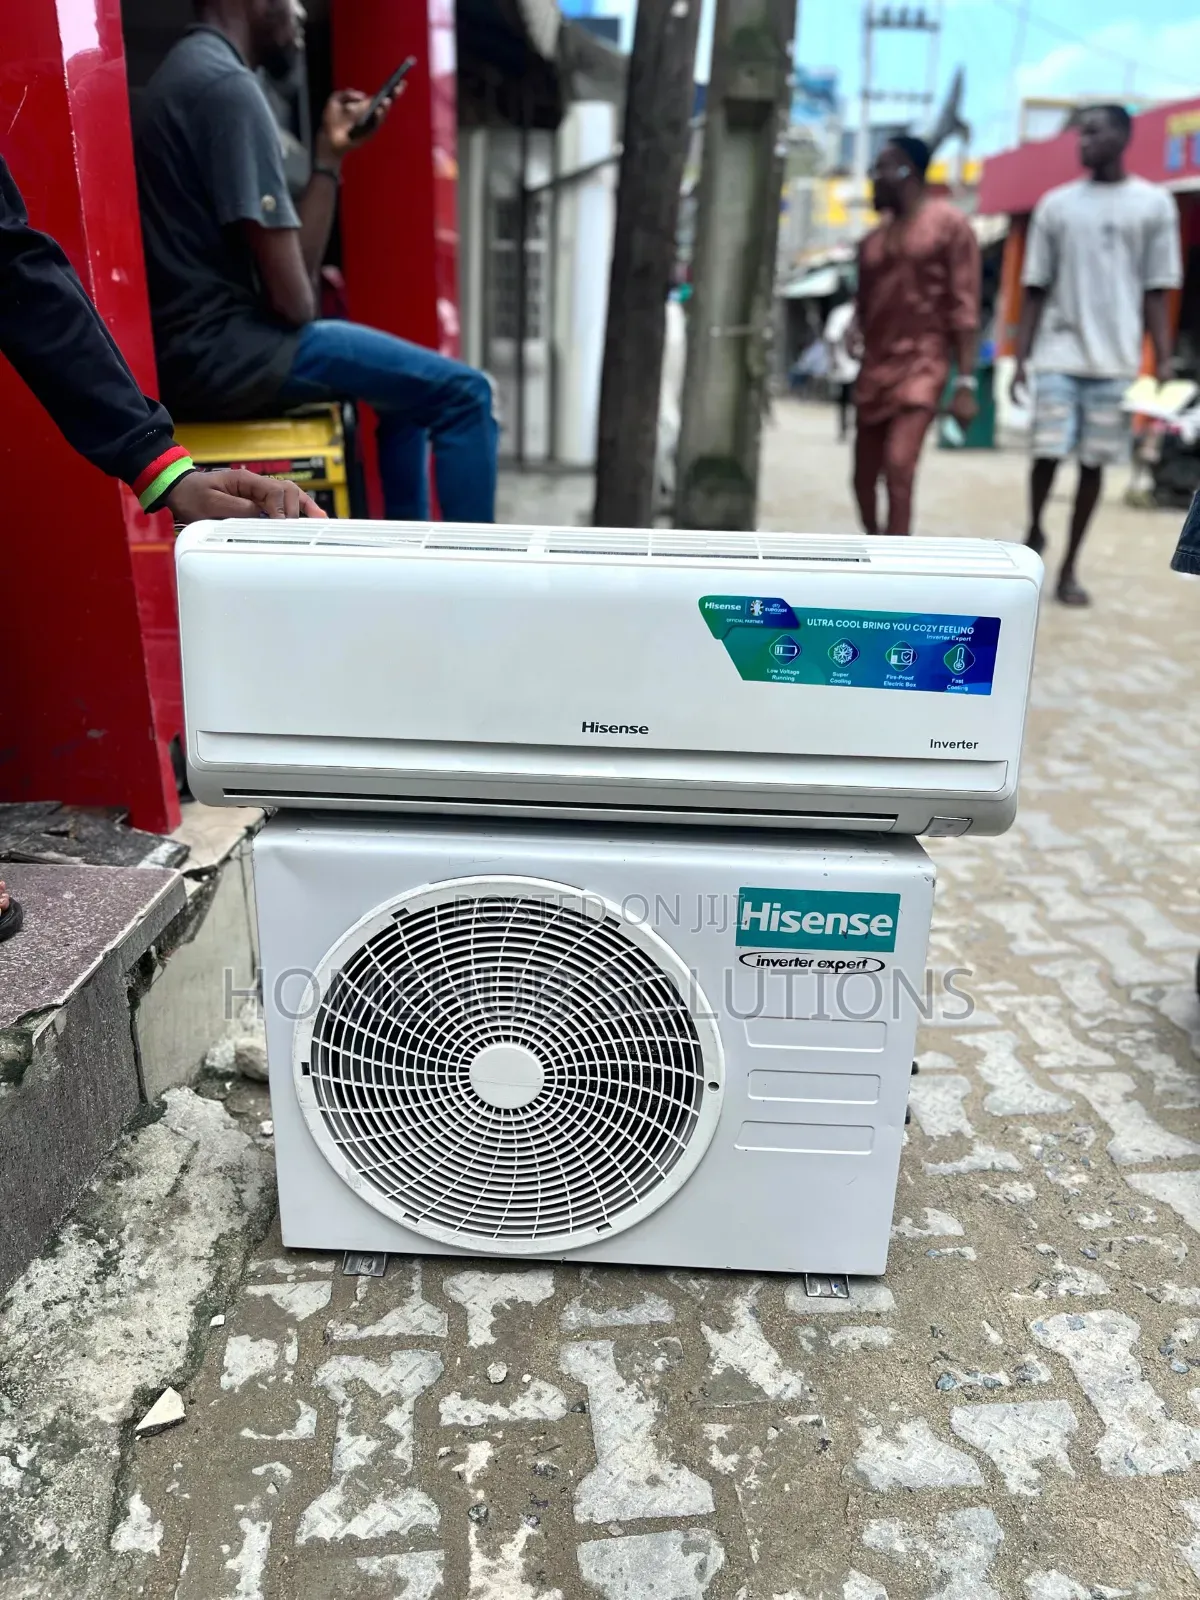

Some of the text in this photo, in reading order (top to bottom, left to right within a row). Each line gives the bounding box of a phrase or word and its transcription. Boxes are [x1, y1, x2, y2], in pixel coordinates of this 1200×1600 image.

[704, 601, 742, 611] Hisense
[807, 618, 975, 635] ULTRA COOL BRING YOU COZY FEELING
[951, 635, 972, 643] Expert
[771, 674, 796, 682] Running
[946, 684, 969, 692] Cooling
[581, 721, 649, 735] Hisense
[929, 738, 979, 751] Inverter
[740, 901, 894, 937] Hisense
[755, 954, 869, 973] inverter expert
